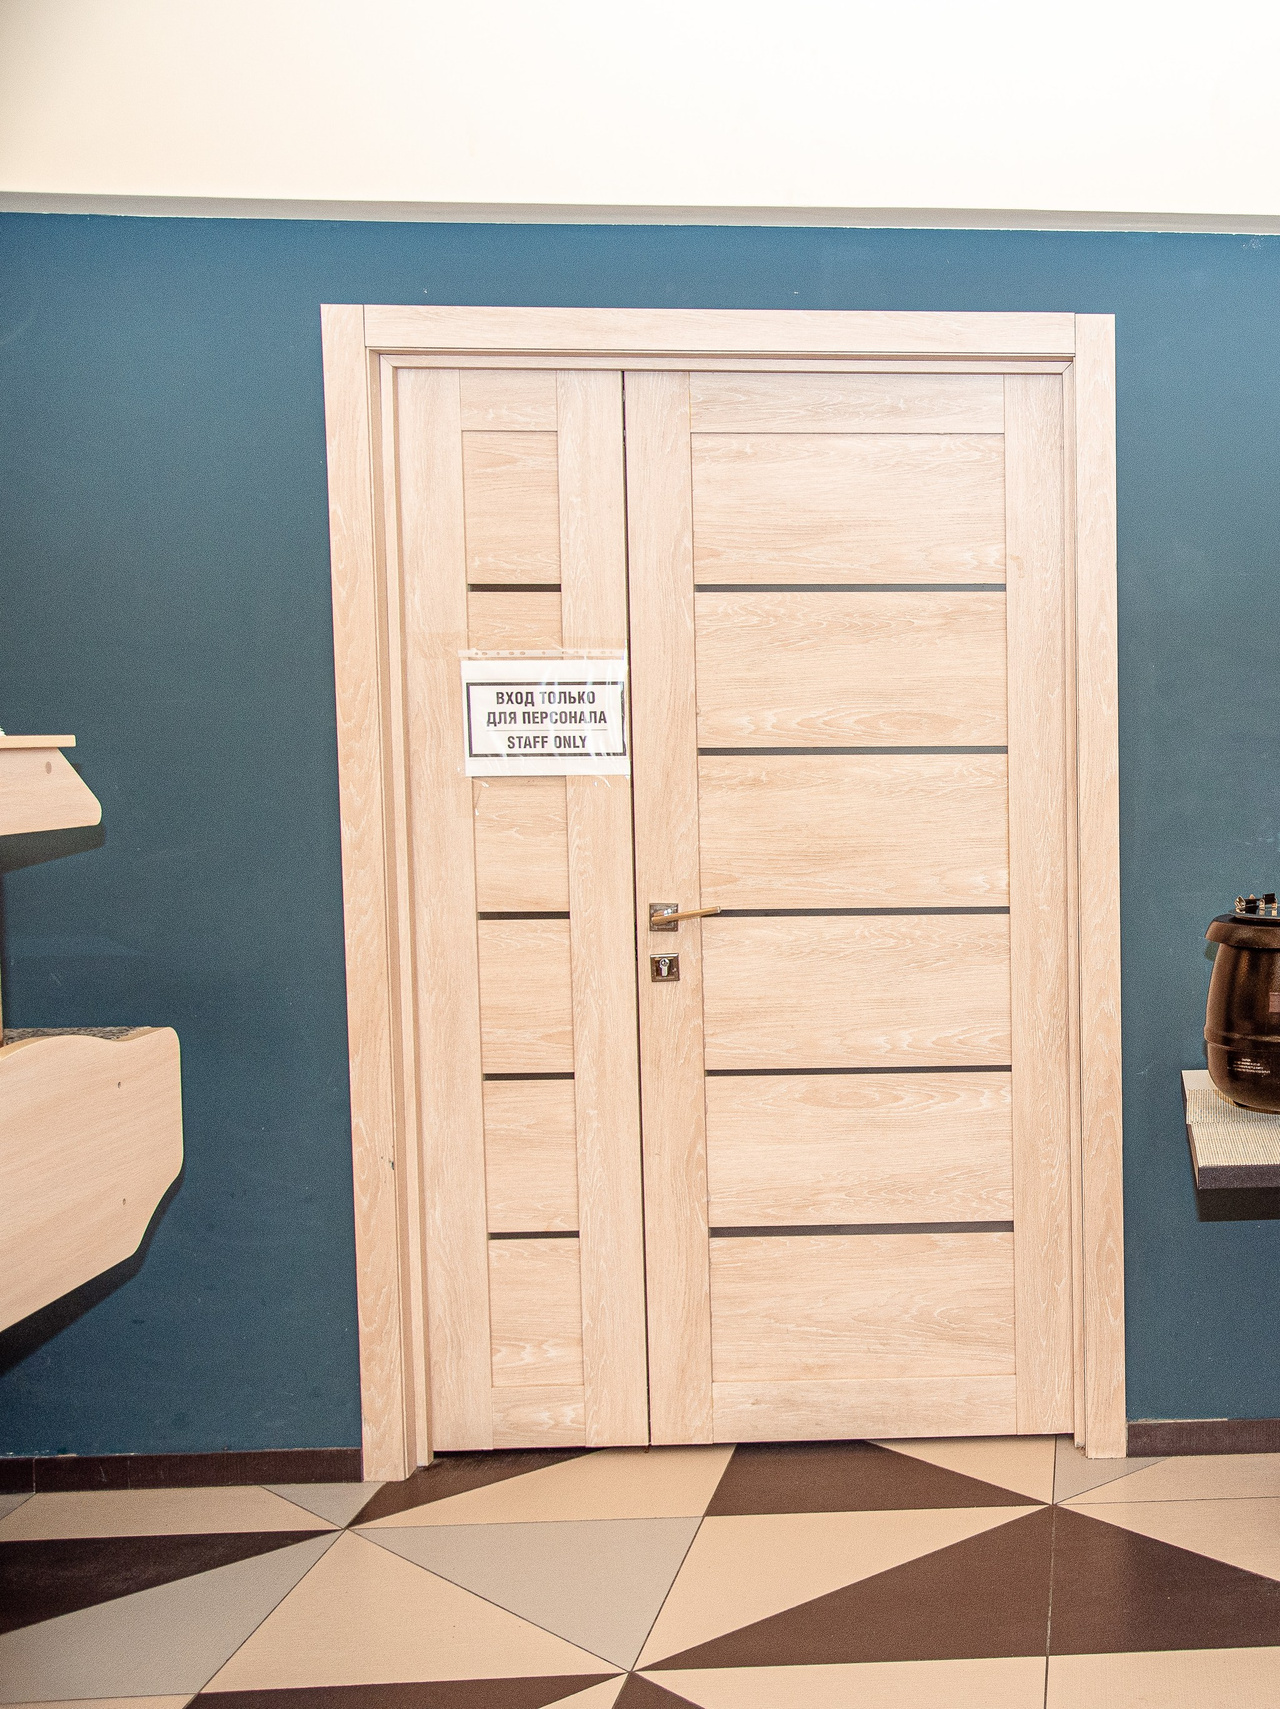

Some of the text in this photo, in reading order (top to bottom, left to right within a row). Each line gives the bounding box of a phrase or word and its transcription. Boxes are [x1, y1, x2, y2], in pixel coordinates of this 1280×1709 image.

[496, 691, 596, 706] ВХОД ТОЛЬКО
[486, 711, 607, 727] ДЛЯ ПЕРСОНАЛА
[507, 735, 587, 749] STAFF ONLY
